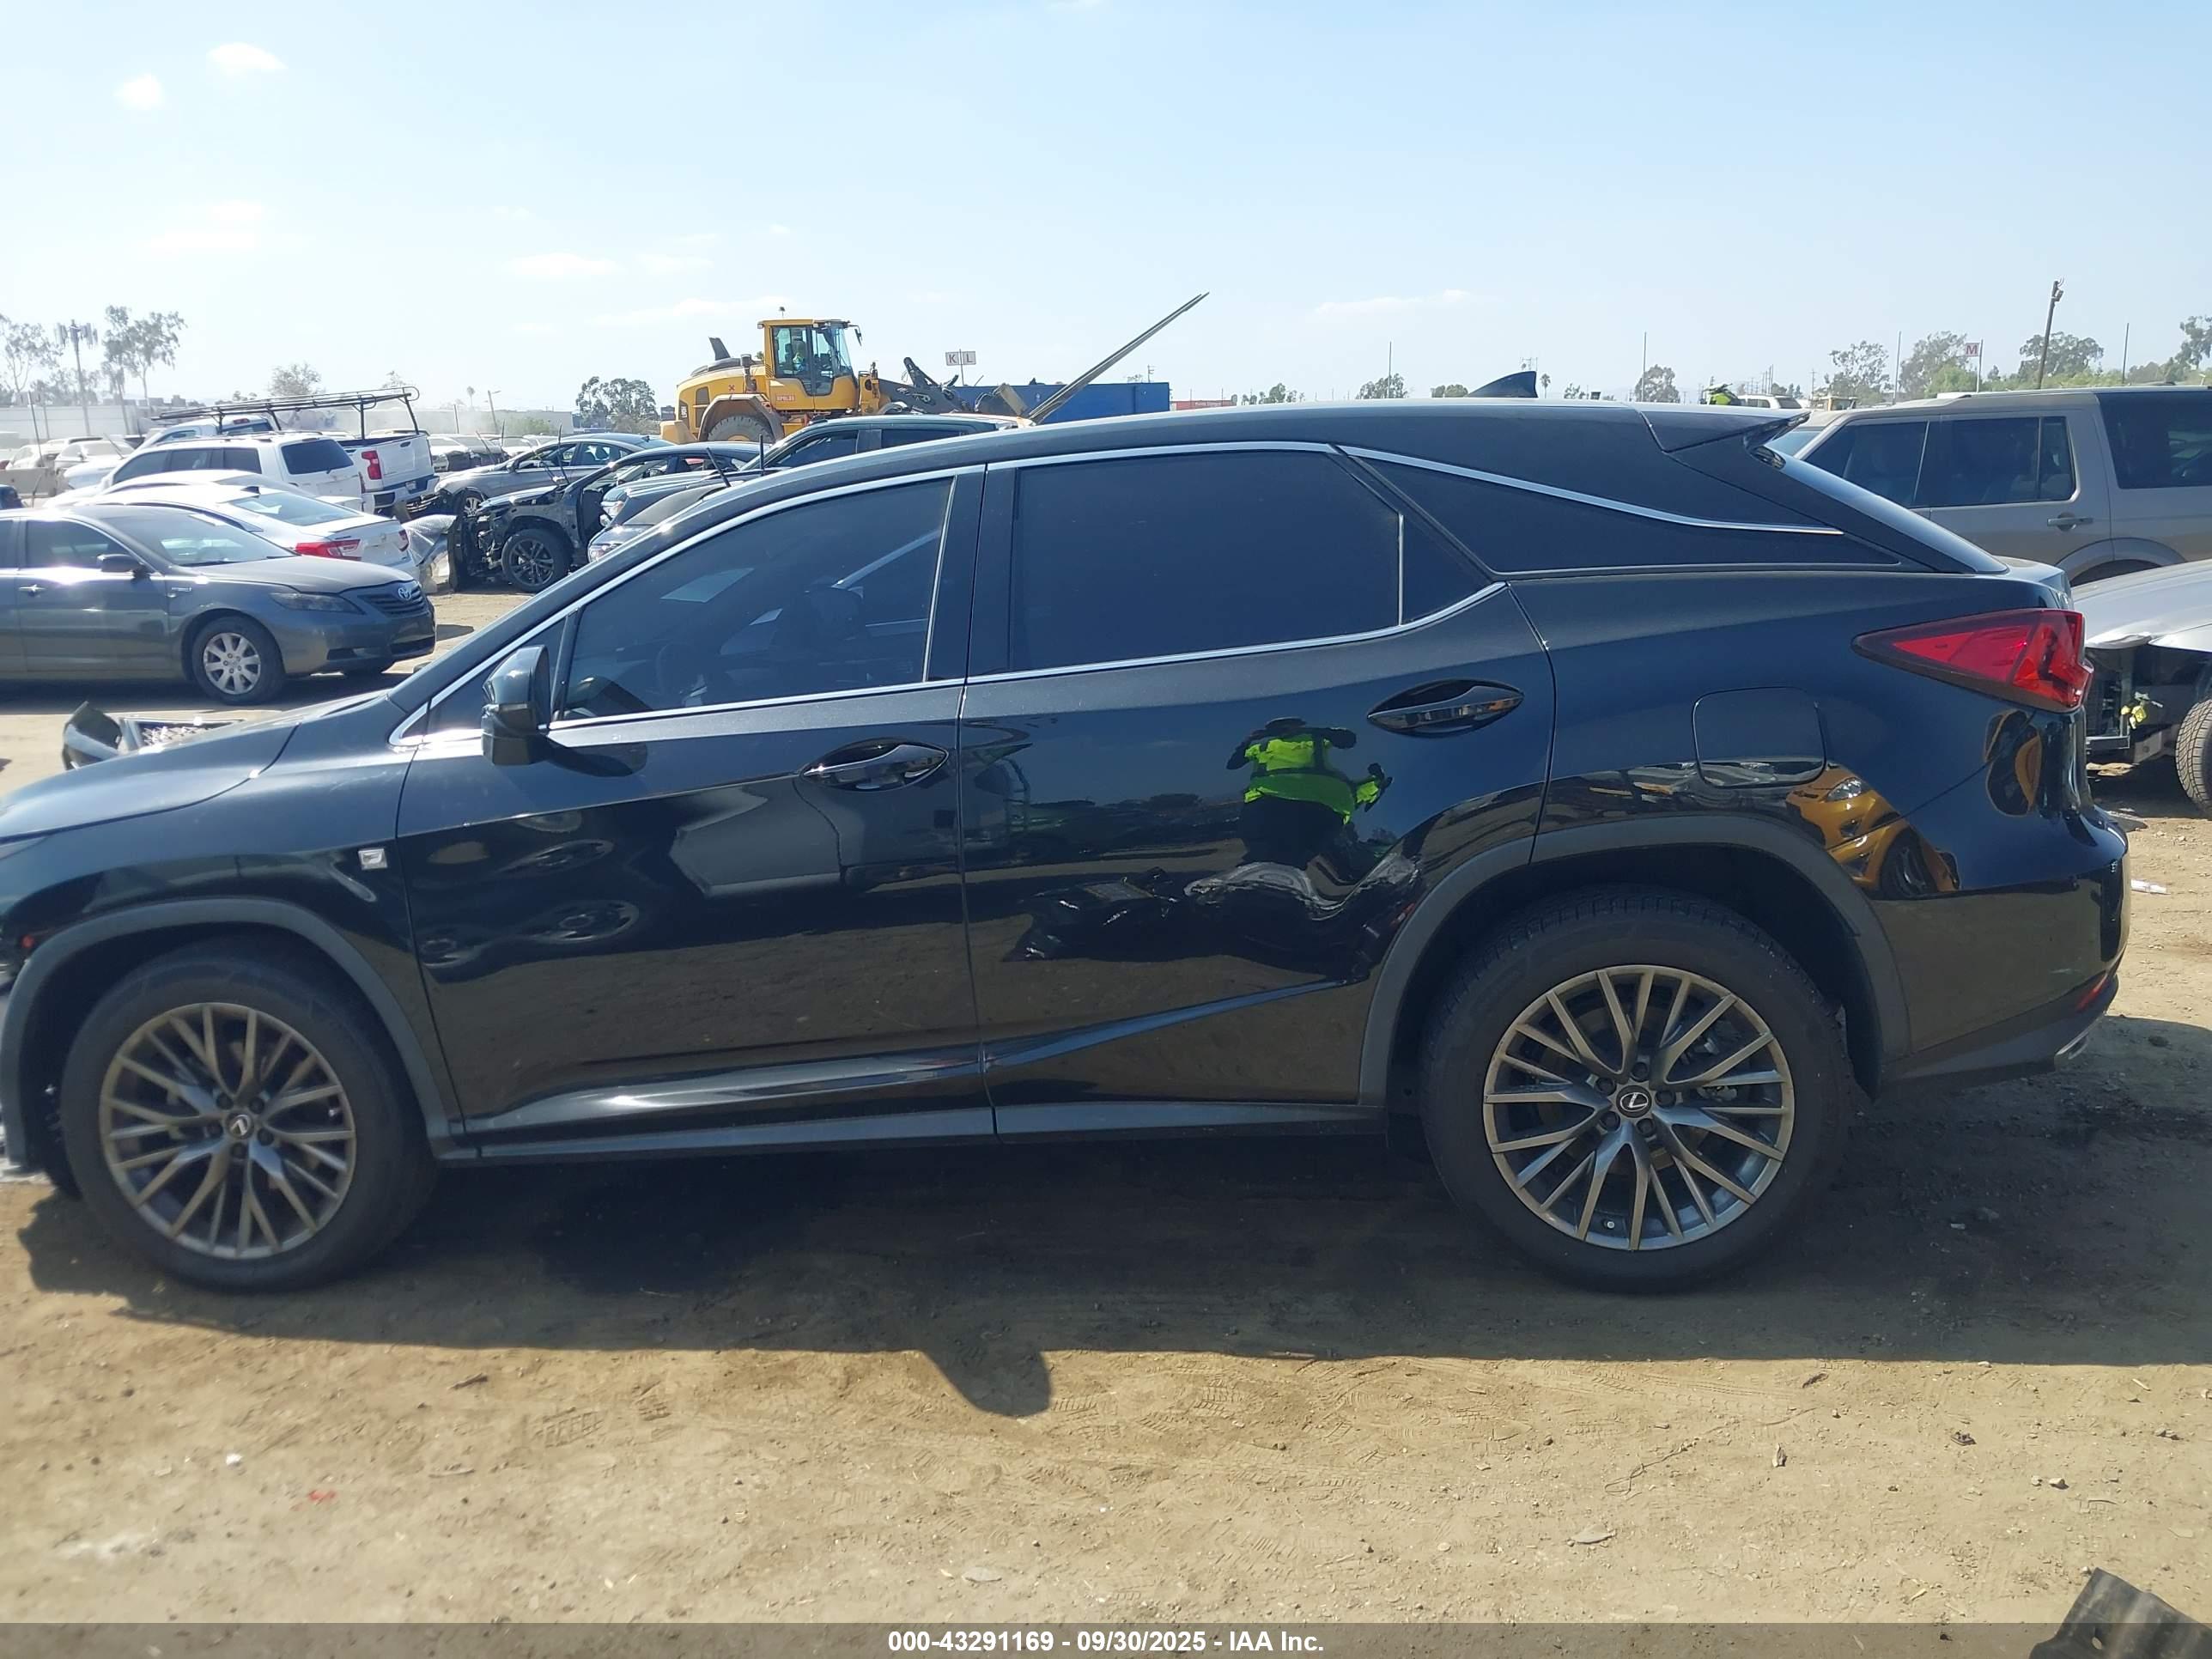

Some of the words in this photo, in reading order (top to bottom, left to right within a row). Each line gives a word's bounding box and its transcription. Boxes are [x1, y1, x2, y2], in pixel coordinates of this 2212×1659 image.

[1966, 344, 1978, 355] M
[948, 354, 957, 363] K
[966, 353, 974, 363] L
